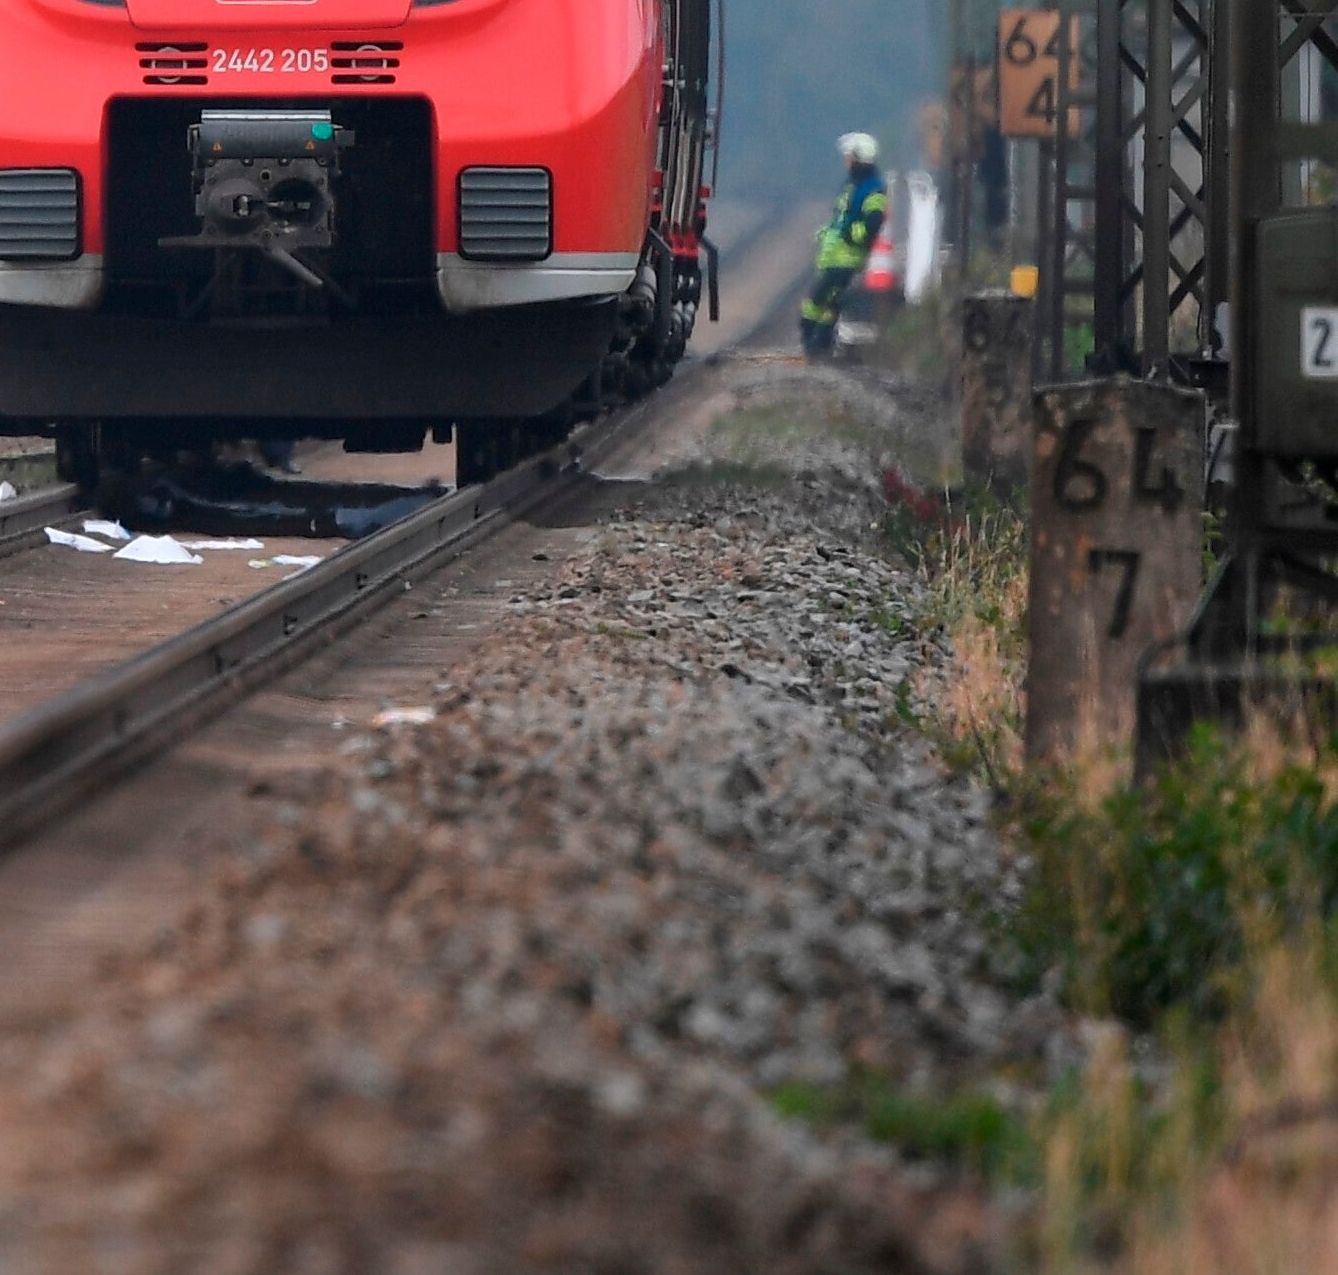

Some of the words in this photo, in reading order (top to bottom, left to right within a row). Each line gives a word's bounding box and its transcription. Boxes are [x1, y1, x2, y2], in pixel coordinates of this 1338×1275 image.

[212, 48, 274, 72] 2442
[280, 48, 328, 72] 205
[1025, 78, 1057, 123] 4
[1055, 422, 1184, 514] 64
[1090, 549, 1141, 638] 7
